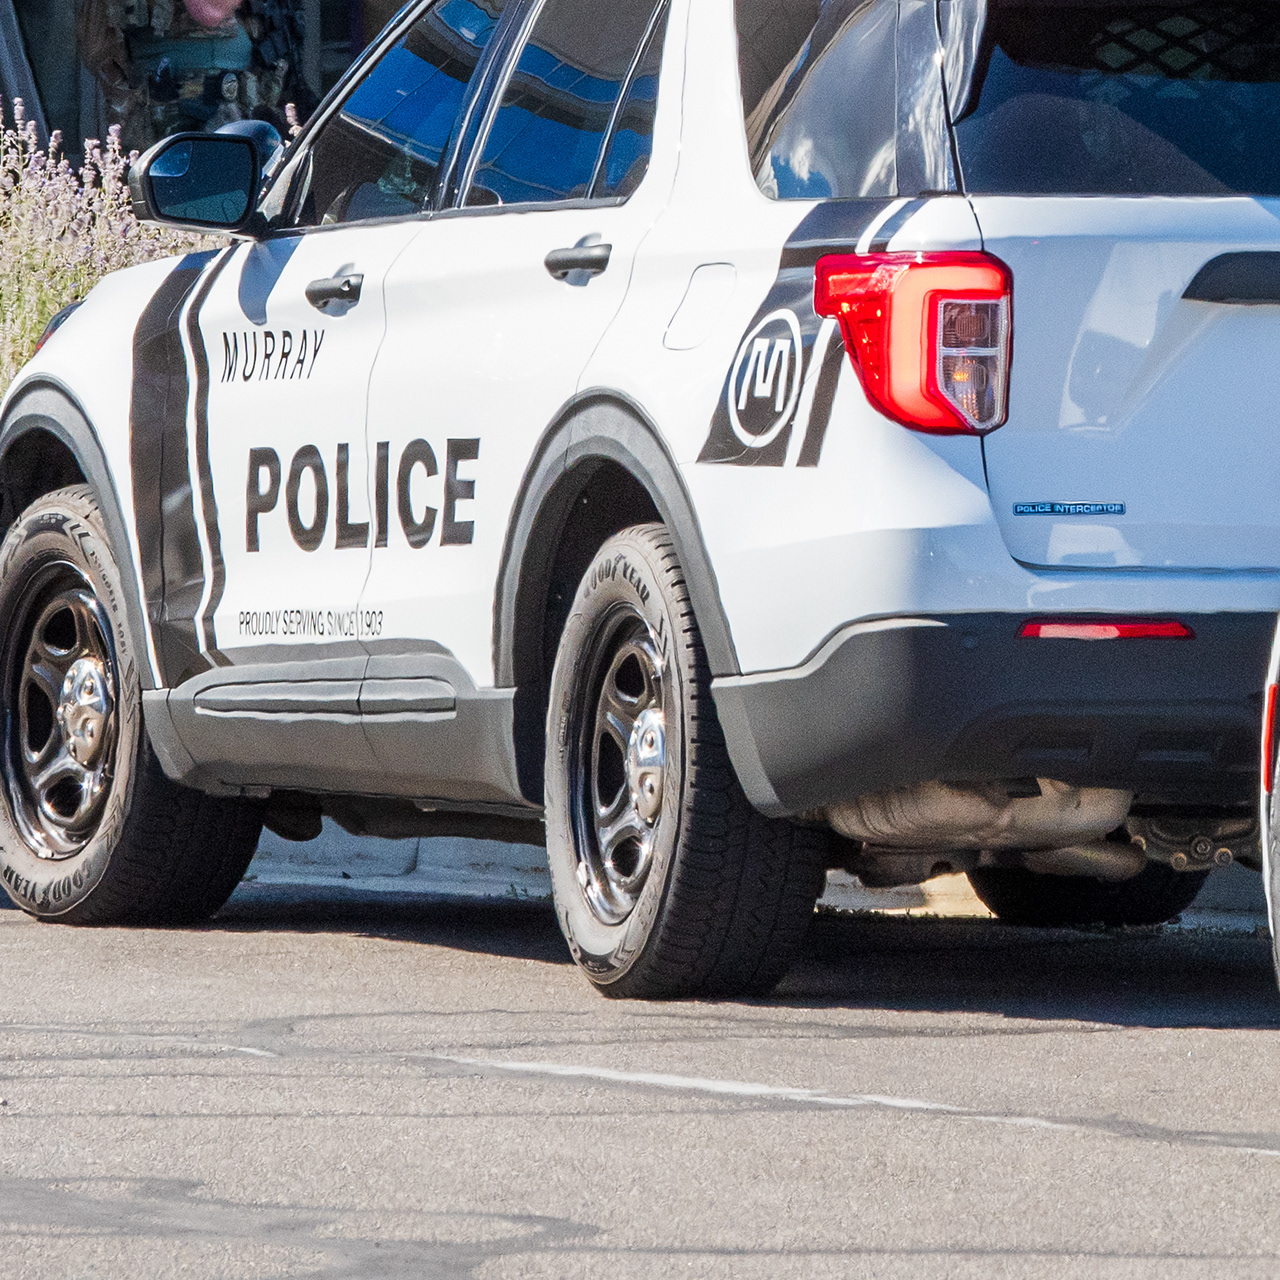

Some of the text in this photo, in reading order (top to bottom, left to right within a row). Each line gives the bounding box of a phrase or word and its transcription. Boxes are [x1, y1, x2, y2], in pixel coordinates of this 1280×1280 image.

[221, 329, 325, 382] MURRAY
[246, 437, 481, 553] POLICE
[1016, 503, 1052, 513] POLICE
[238, 609, 384, 637] PROUDLY SERVING SINCE 1903
